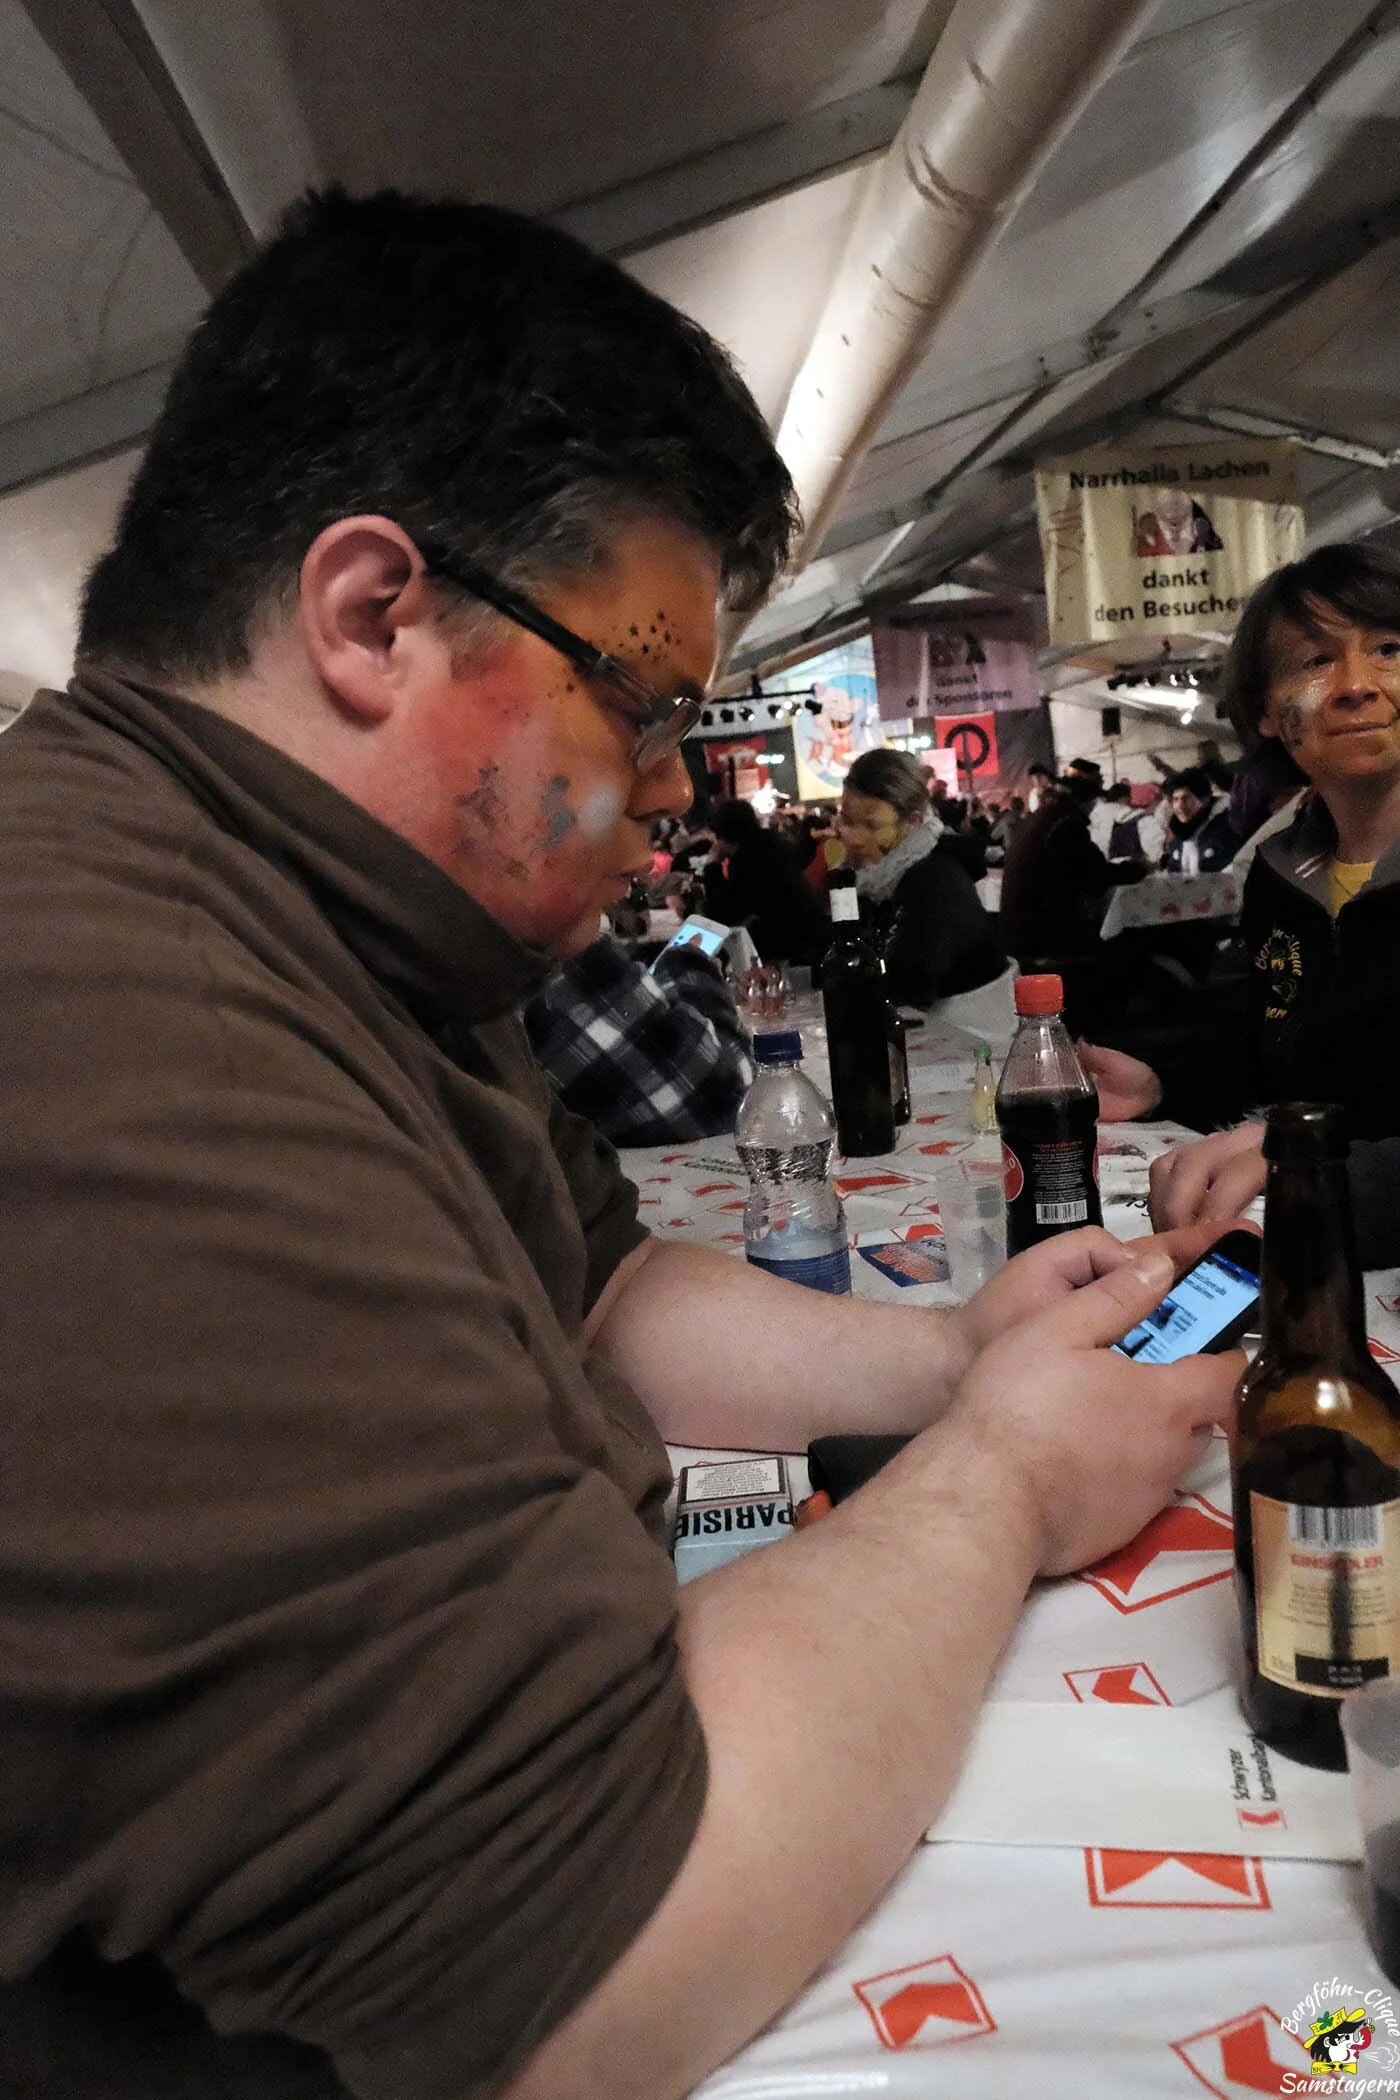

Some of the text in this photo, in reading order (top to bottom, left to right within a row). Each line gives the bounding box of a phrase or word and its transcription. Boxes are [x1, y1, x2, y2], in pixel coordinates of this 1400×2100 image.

[1188, 459, 1271, 482] Lachen
[1142, 568, 1209, 589] dankt
[1094, 602, 1135, 622] den
